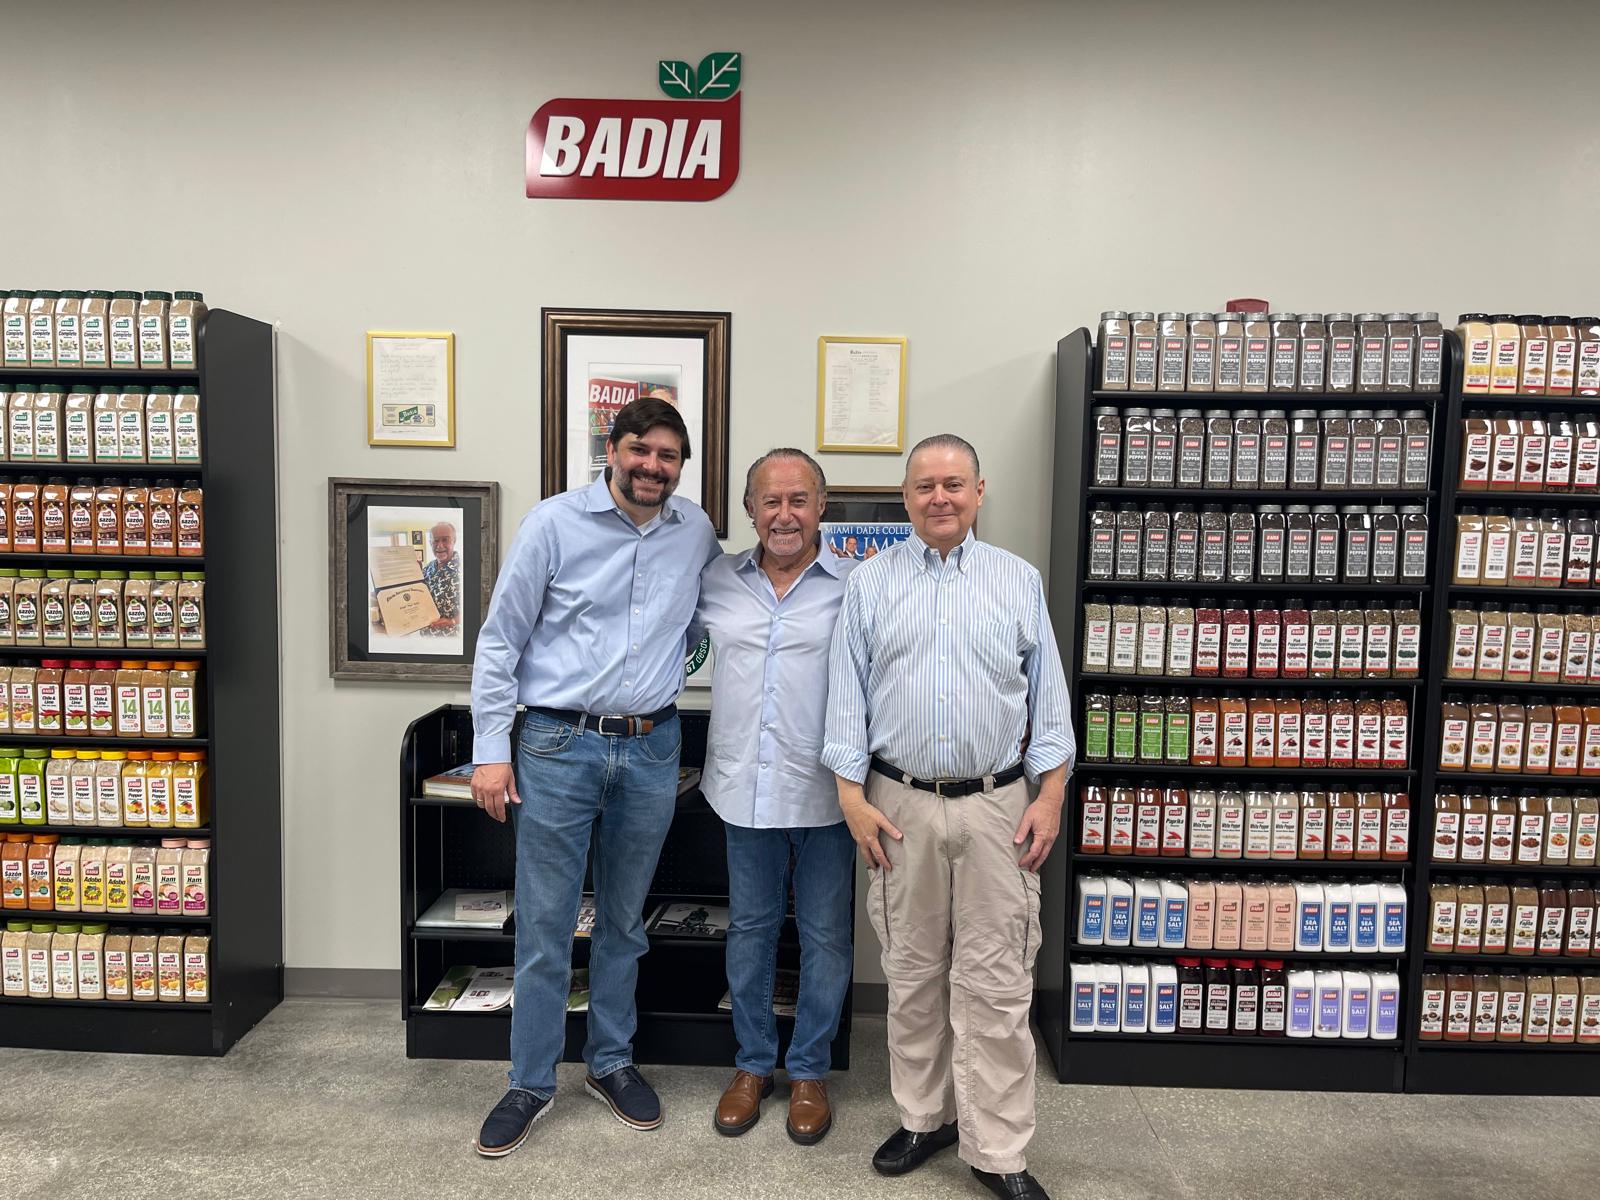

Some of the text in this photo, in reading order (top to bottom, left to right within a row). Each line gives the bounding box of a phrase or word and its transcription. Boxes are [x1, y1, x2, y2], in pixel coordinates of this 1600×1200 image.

[540, 116, 722, 179] BADIA
[589, 384, 635, 404] BADIA
[824, 526, 853, 534] MIAMI
[122, 700, 137, 714] 14
[148, 700, 163, 714] 14
[175, 700, 190, 714] 14
